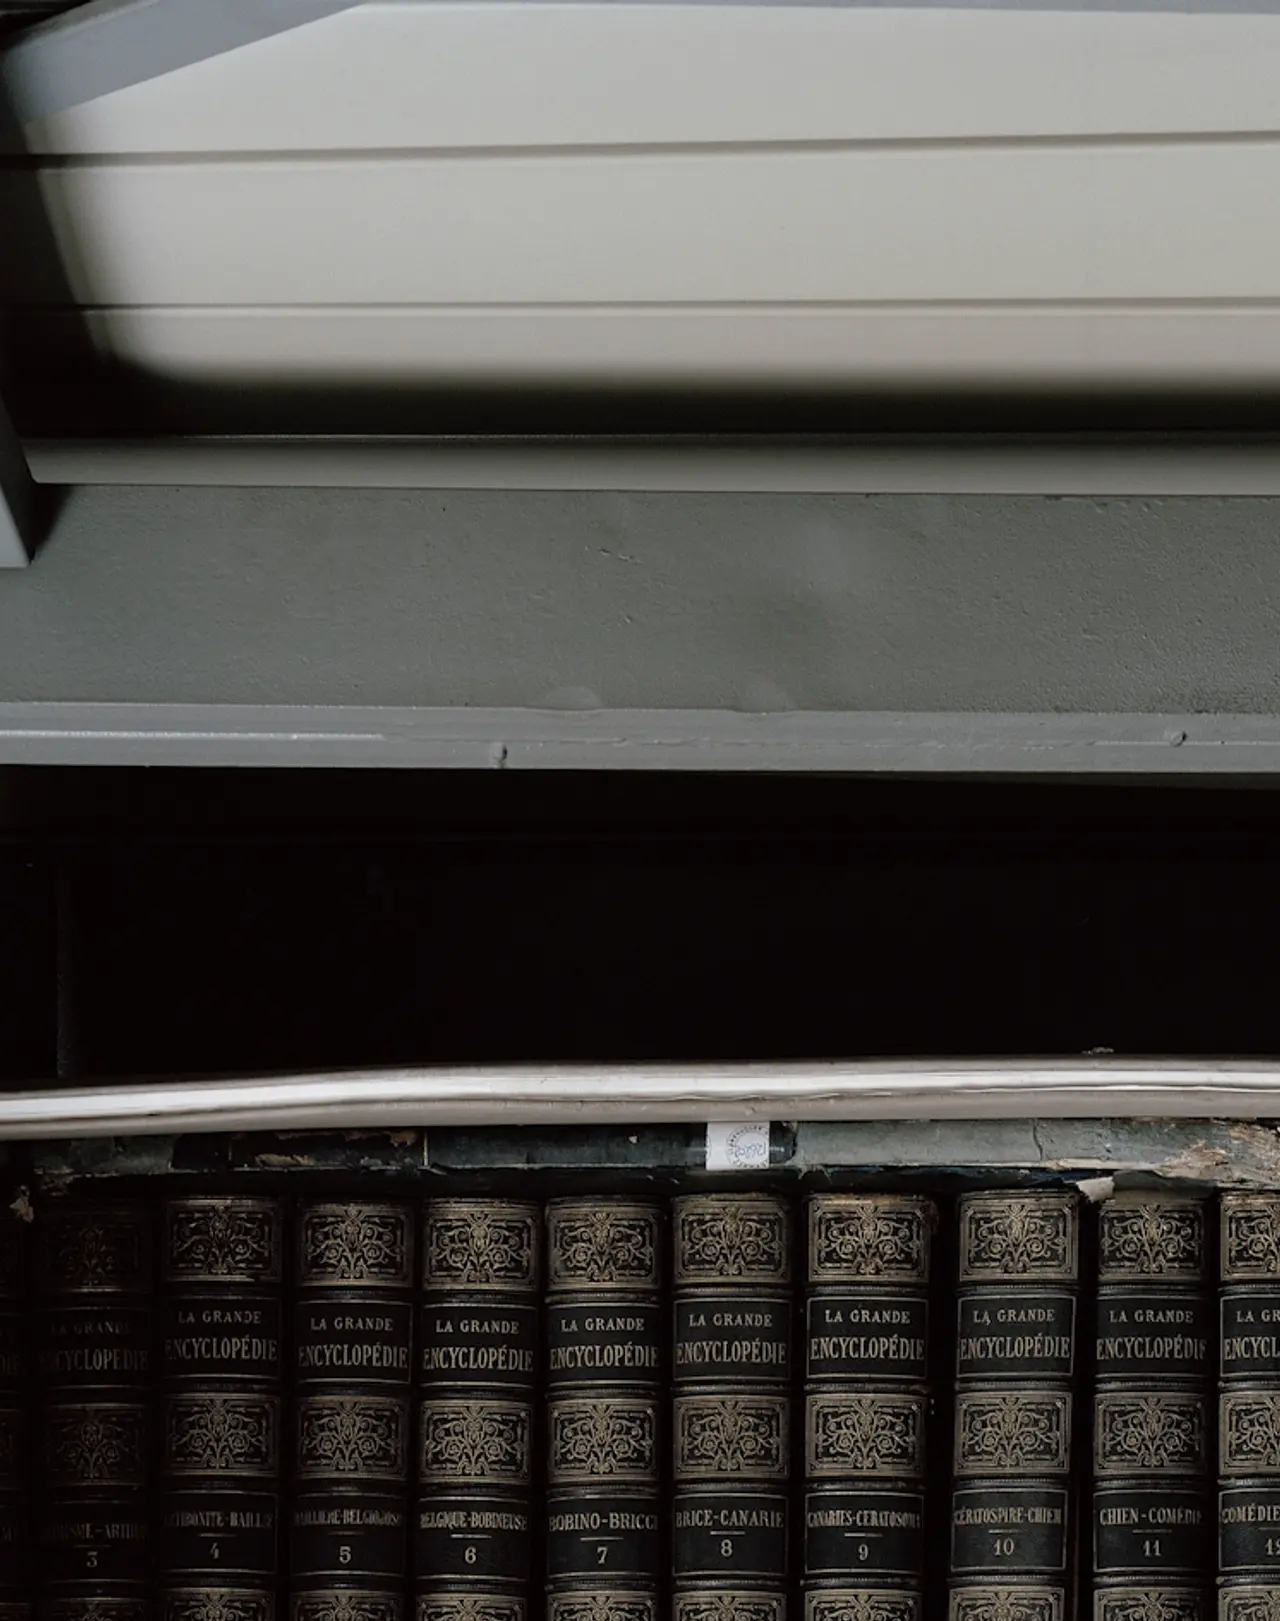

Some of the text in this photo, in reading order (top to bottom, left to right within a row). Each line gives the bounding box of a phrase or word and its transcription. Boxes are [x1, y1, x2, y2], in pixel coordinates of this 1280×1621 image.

[178, 1309, 262, 1324] LA GRANDE
[310, 1316, 394, 1331] LA GRANDE
[561, 1317, 645, 1332] LA GRANDE
[688, 1313, 773, 1327] LA GRANDE
[825, 1308, 911, 1324] LA GRANDE
[973, 1309, 1055, 1326] LA GRANDE
[1109, 1309, 1194, 1324] LA GRANDE
[1236, 1310, 1255, 1323] LA
[435, 1319, 520, 1334] LA GRANDE
[298, 1342, 409, 1368] ENCYCLOPÉDIE
[550, 1341, 659, 1369] ENCYCLOPÉDIE
[677, 1337, 787, 1364] ENCYCLOPÉDIE
[810, 1333, 925, 1360] ENCYCLOPÉDIE
[960, 1332, 1070, 1360] ENCYCLOPÉDIE
[1096, 1332, 1207, 1361] ENCYCLOPÉDIE
[423, 1344, 534, 1372] ENCYCLOPÉDIE
[549, 1512, 658, 1531] BOBINO-BRICCI
[676, 1510, 784, 1528] BRICE-CANARIE
[210, 1542, 220, 1560] 4
[339, 1545, 352, 1564] 5
[464, 1546, 477, 1564] 6
[596, 1546, 608, 1564] 7
[721, 1539, 733, 1558] 8
[858, 1543, 869, 1561] 9
[993, 1537, 1015, 1557] 10
[1142, 1540, 1162, 1557] 11
[86, 1551, 98, 1568] 3
